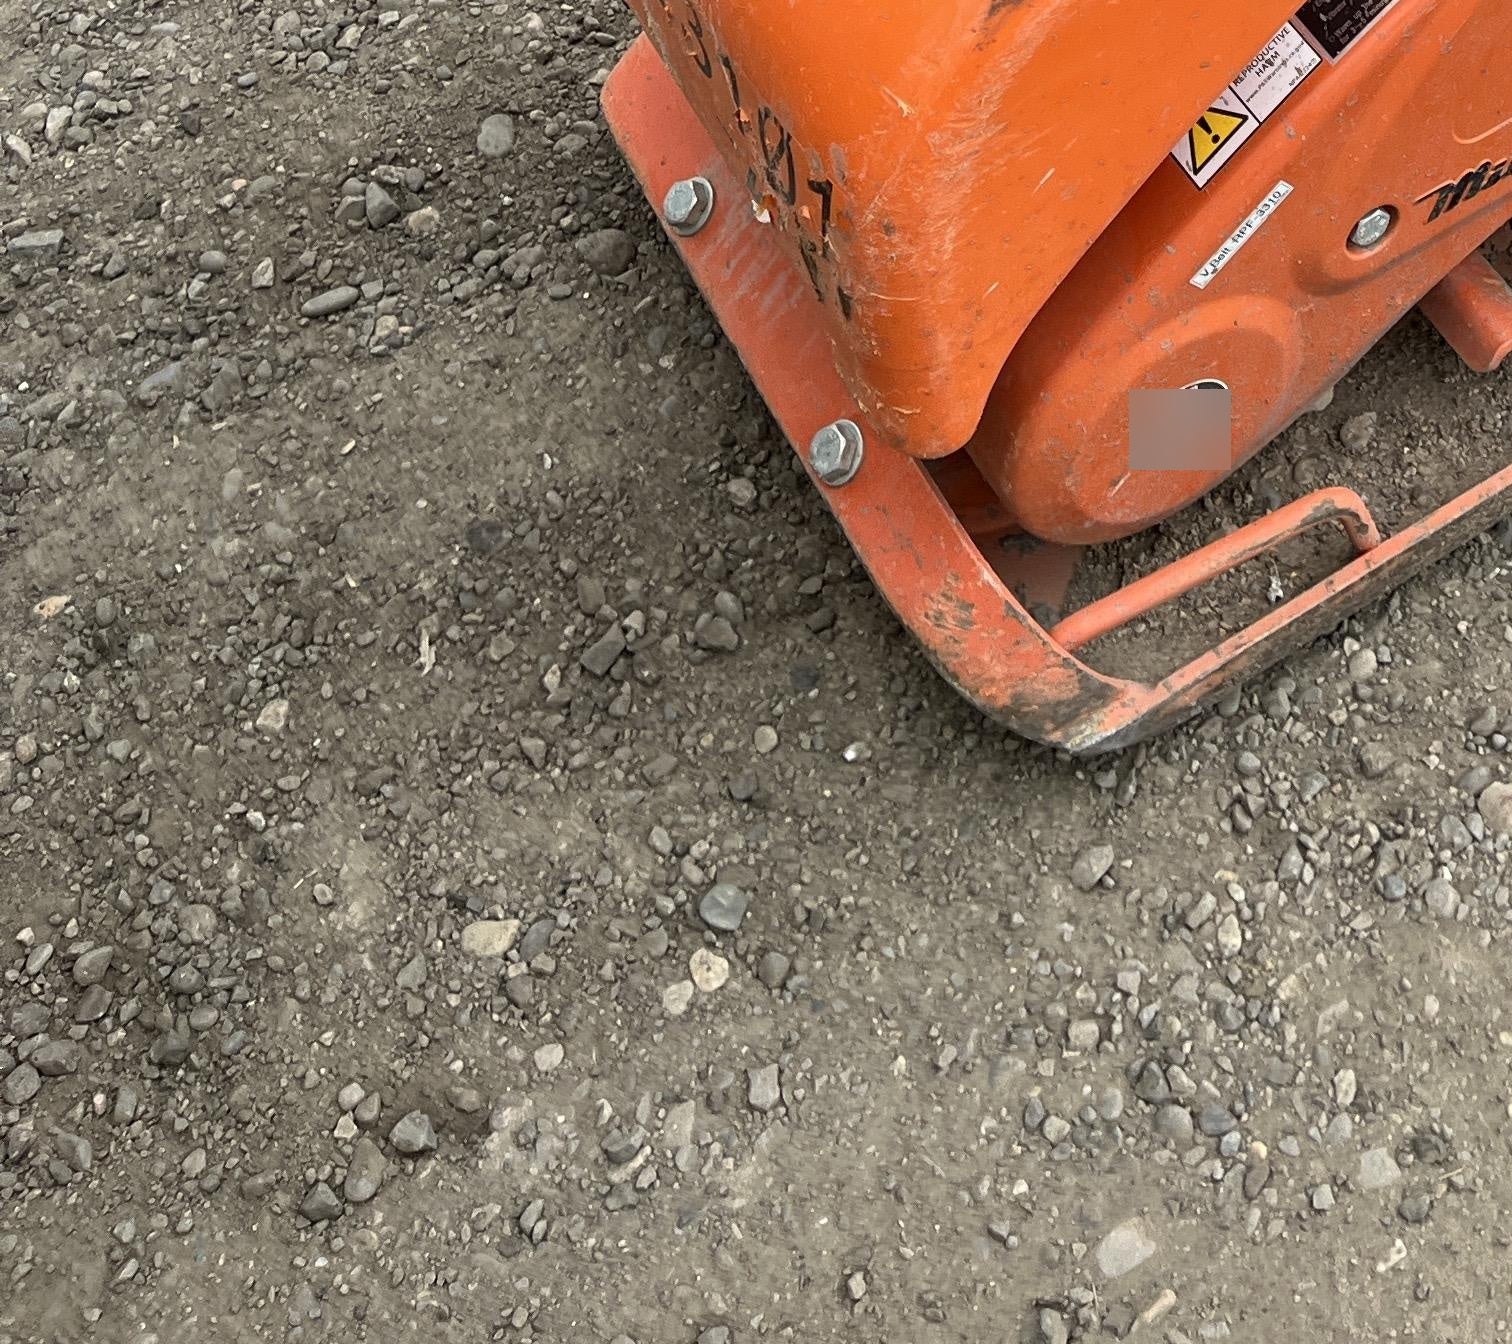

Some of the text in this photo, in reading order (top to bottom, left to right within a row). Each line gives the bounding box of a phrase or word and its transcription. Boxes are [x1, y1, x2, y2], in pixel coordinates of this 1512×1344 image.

[1233, 26, 1291, 88] REPRODUCTIVE
[1209, 247, 1231, 271] Belt
[1231, 191, 1282, 244] RPF-3310
